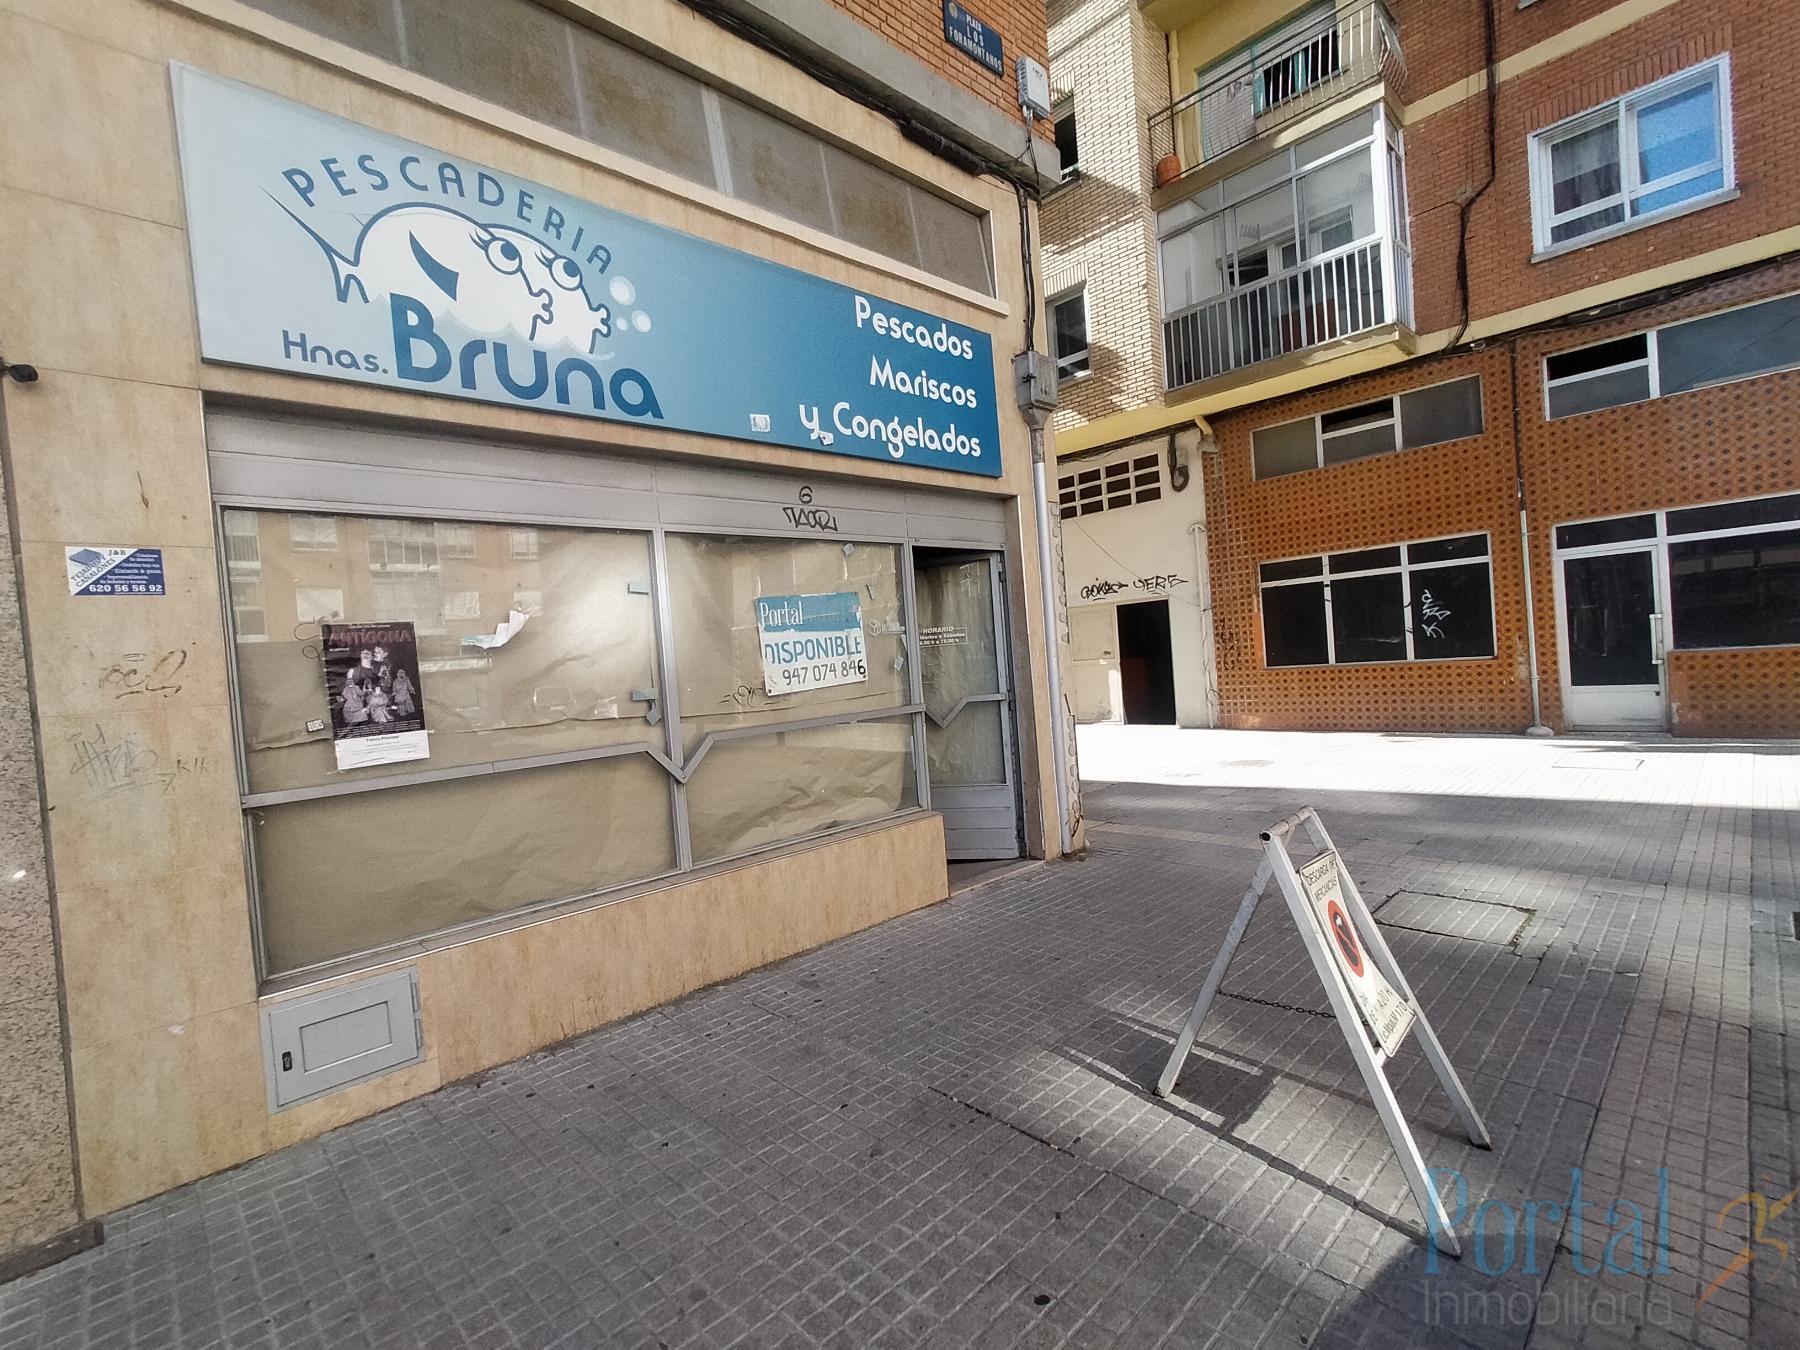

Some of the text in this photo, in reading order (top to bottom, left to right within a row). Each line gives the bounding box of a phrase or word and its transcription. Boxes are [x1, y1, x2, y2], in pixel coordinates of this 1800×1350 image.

[966, 14, 982, 33] PLAZA
[966, 26, 984, 46] LOS
[949, 26, 1002, 71] FORAMONTANOS
[282, 155, 612, 275] PESCADERIA
[855, 295, 973, 360] Pescados
[282, 292, 664, 420] Hnas. Bruna
[870, 355, 977, 409] Mariscos
[832, 402, 981, 458] Congelados
[760, 601, 803, 627] Portal
[765, 635, 862, 664] DISPONIBLE
[783, 659, 866, 686] 947 074 846
